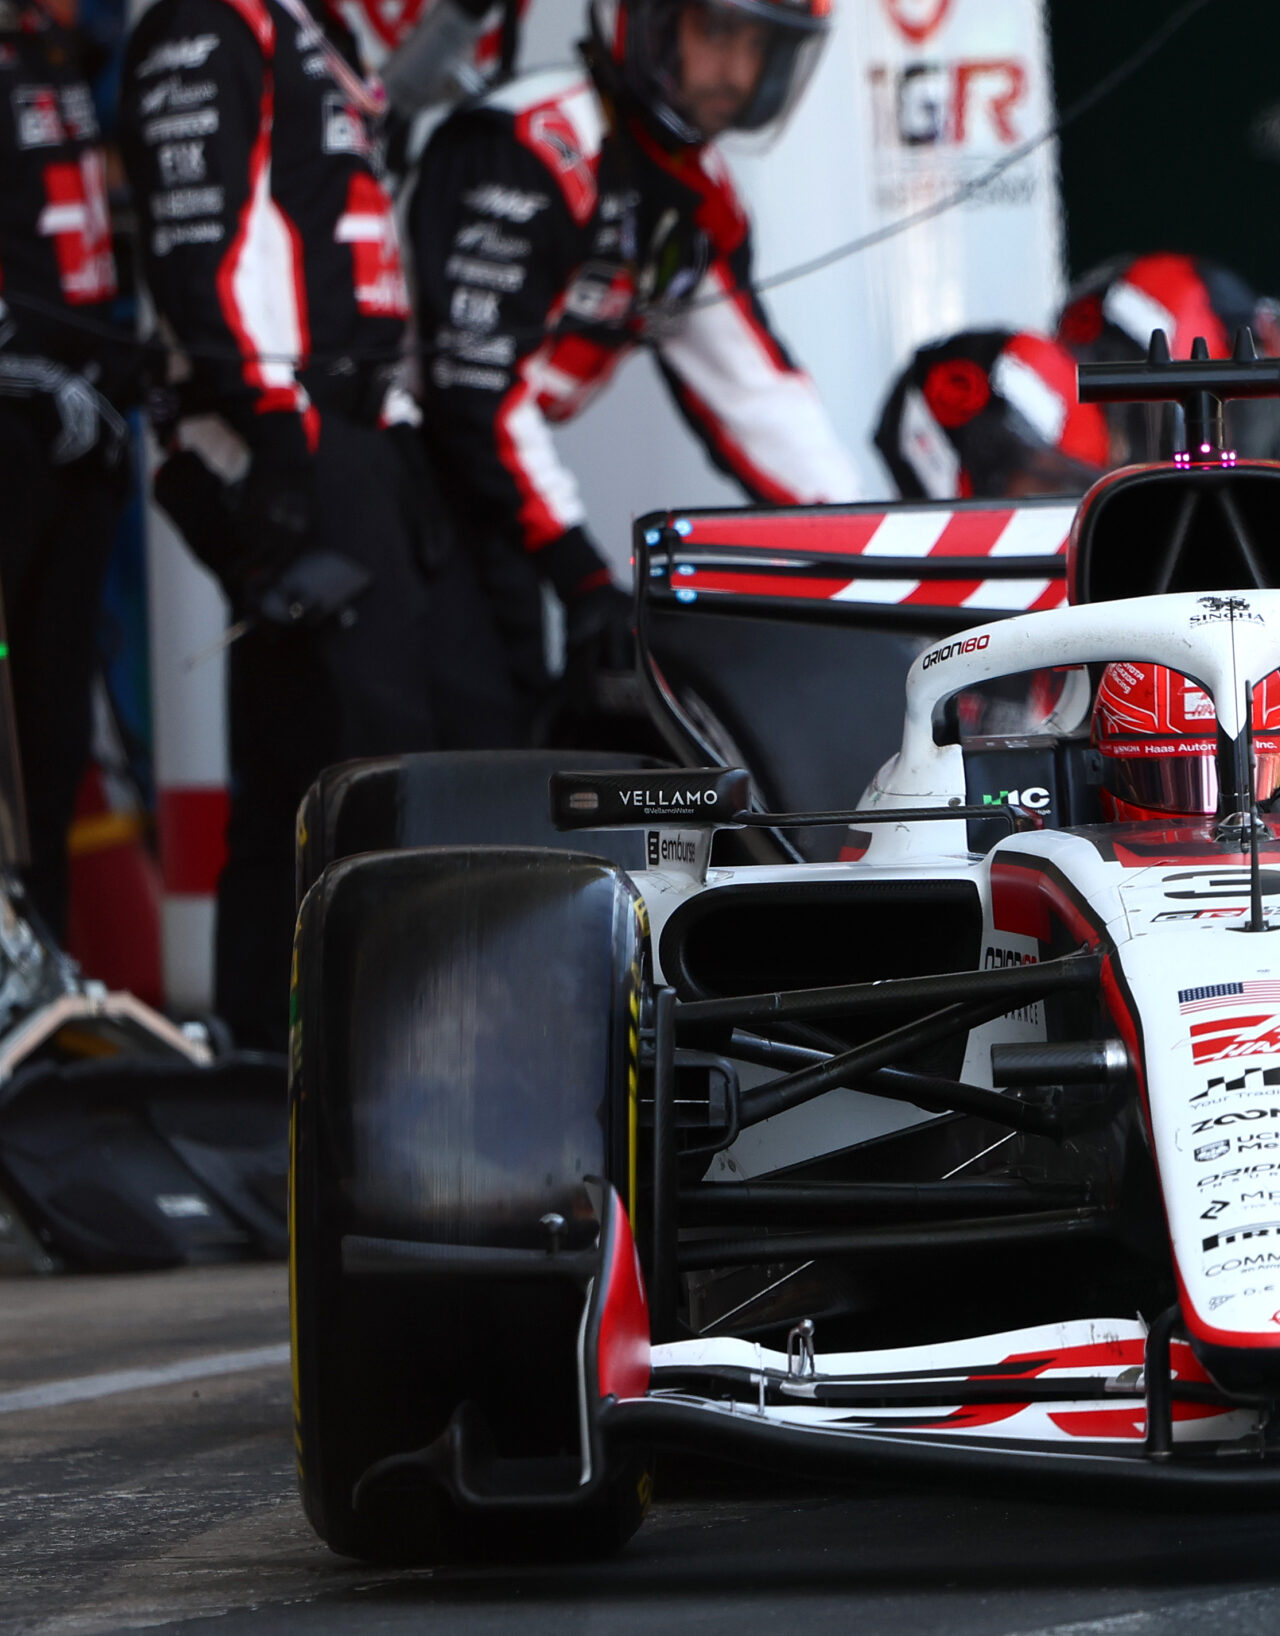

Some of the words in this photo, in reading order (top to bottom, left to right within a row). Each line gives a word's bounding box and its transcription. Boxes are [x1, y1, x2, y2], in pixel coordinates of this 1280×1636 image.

[1189, 612, 1265, 624] SINGHA
[922, 634, 991, 671] ORION180
[1144, 745, 1175, 753] Haas
[1255, 740, 1278, 749] Inc.
[618, 789, 719, 806] VELLAMO
[661, 832, 696, 864] emburse
[1190, 1095, 1228, 1110] Your
